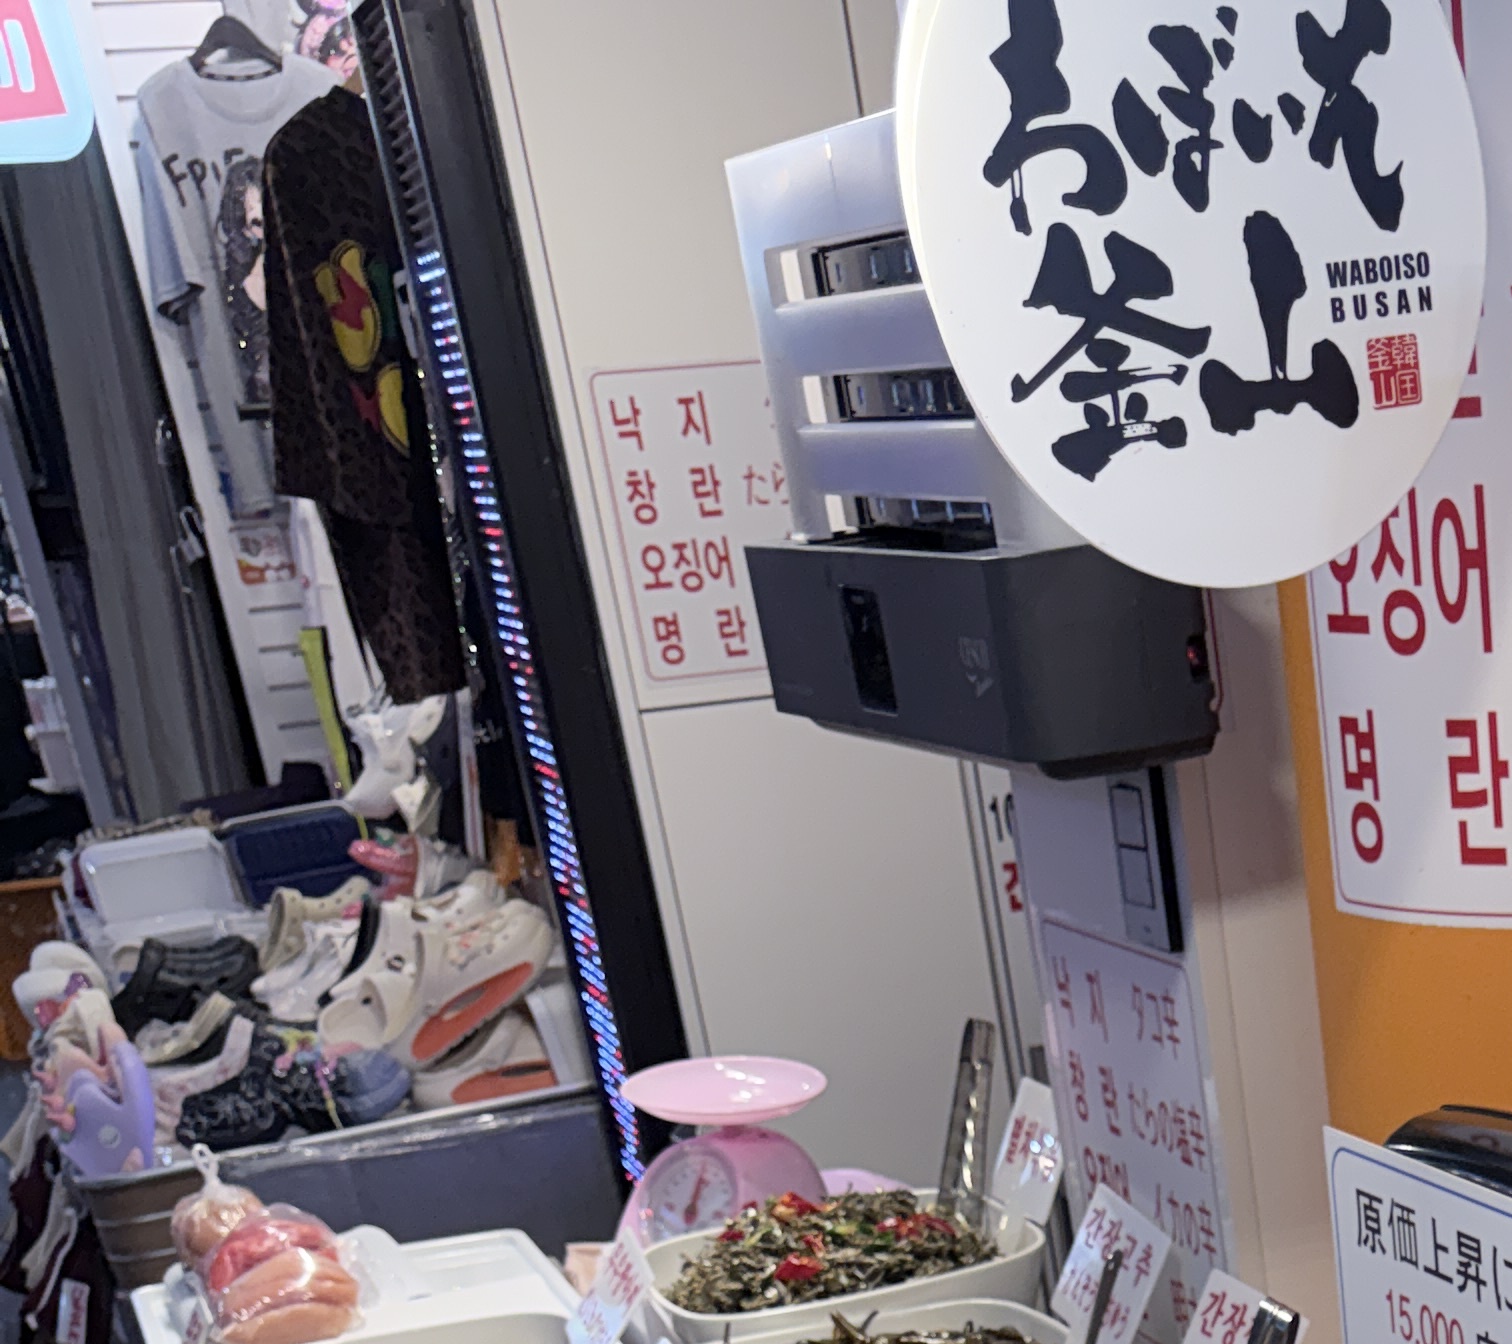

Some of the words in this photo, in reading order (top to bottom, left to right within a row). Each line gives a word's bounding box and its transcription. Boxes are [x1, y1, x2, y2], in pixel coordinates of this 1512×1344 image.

[1326, 251, 1430, 288] WABOISO
[1331, 285, 1433, 323] BUSAN
[1011, 211, 1359, 482] 釜山
[641, 535, 736, 593] 오징어
